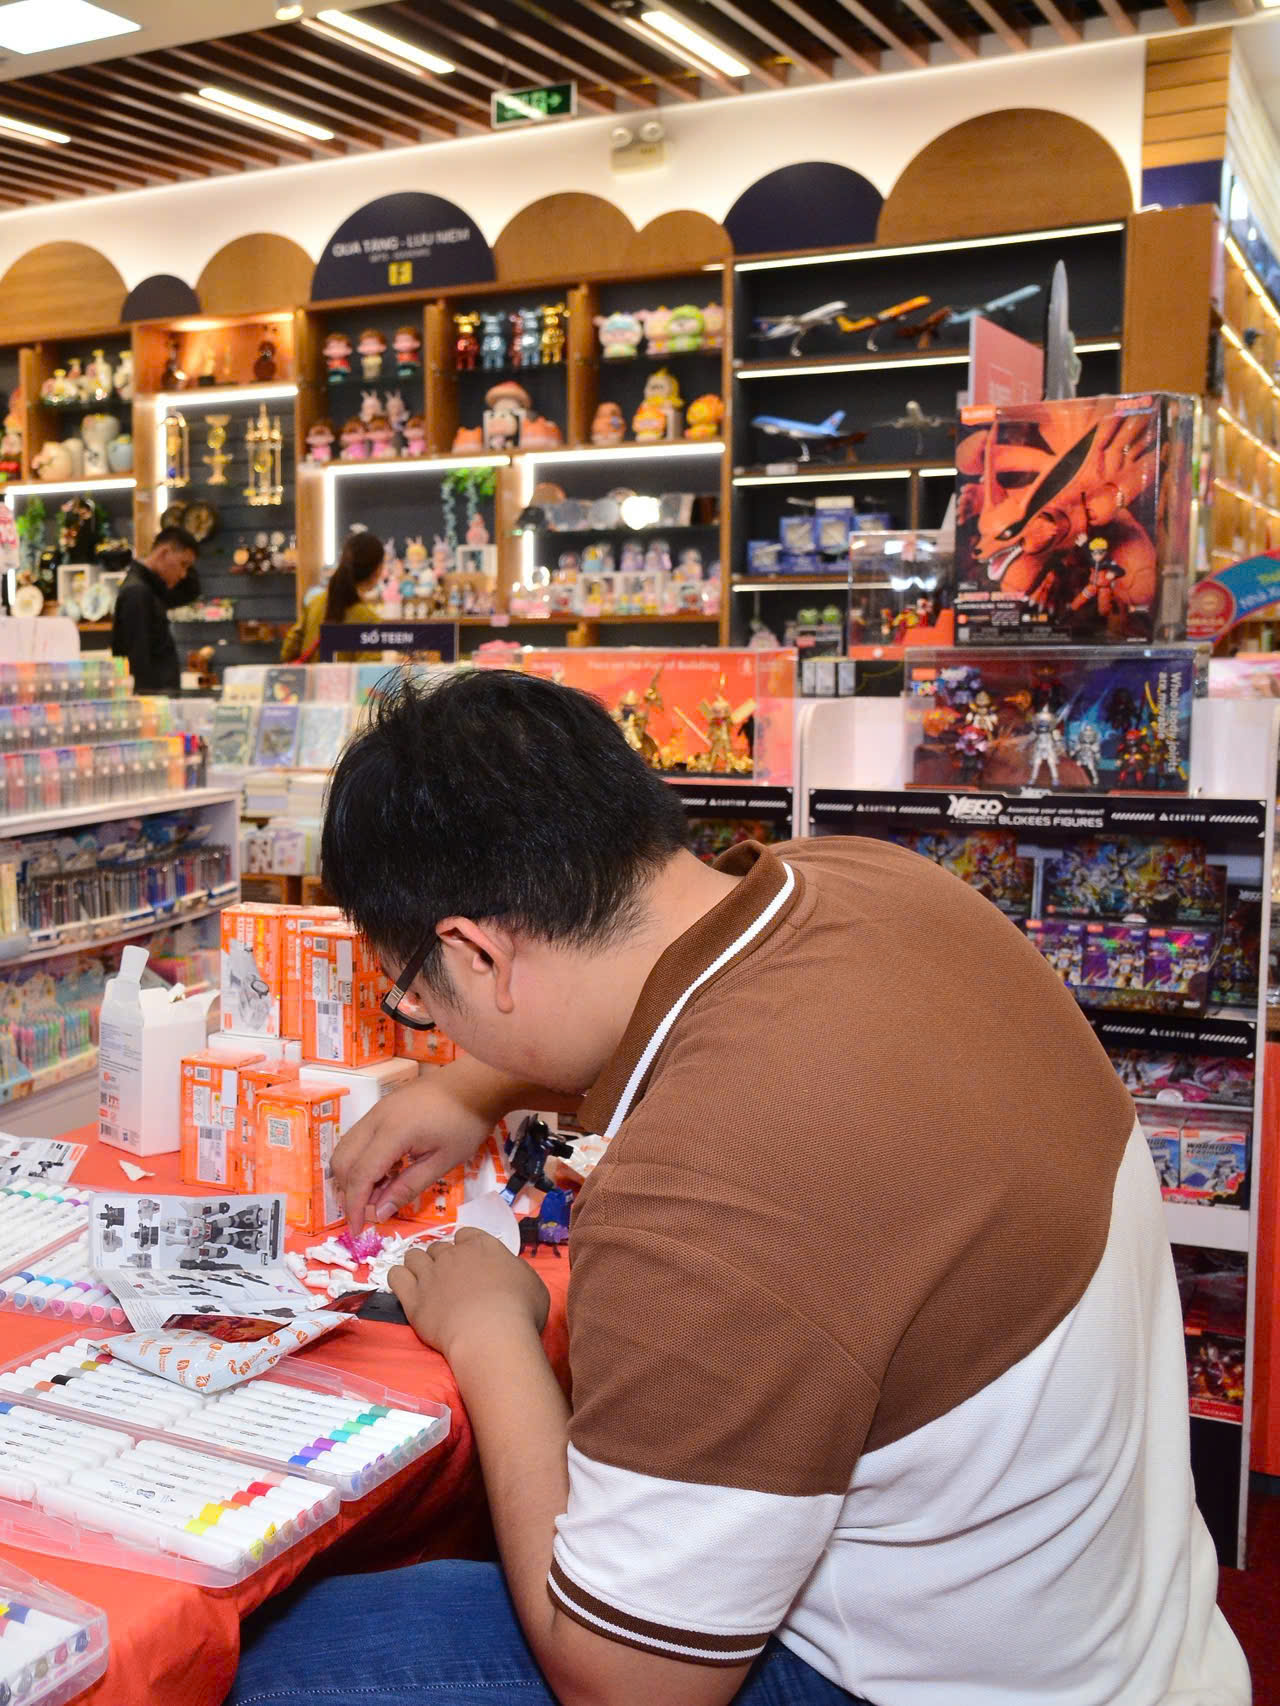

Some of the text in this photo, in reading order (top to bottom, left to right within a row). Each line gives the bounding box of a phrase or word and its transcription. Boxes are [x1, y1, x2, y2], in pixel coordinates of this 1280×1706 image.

[380, 631, 414, 645] TEEN
[1170, 671, 1182, 707] Whole
[998, 815, 1104, 829] BLOKEES FIGURES
[1169, 813, 1206, 823] CAUTION
[1158, 1029, 1196, 1040] CAUTION
